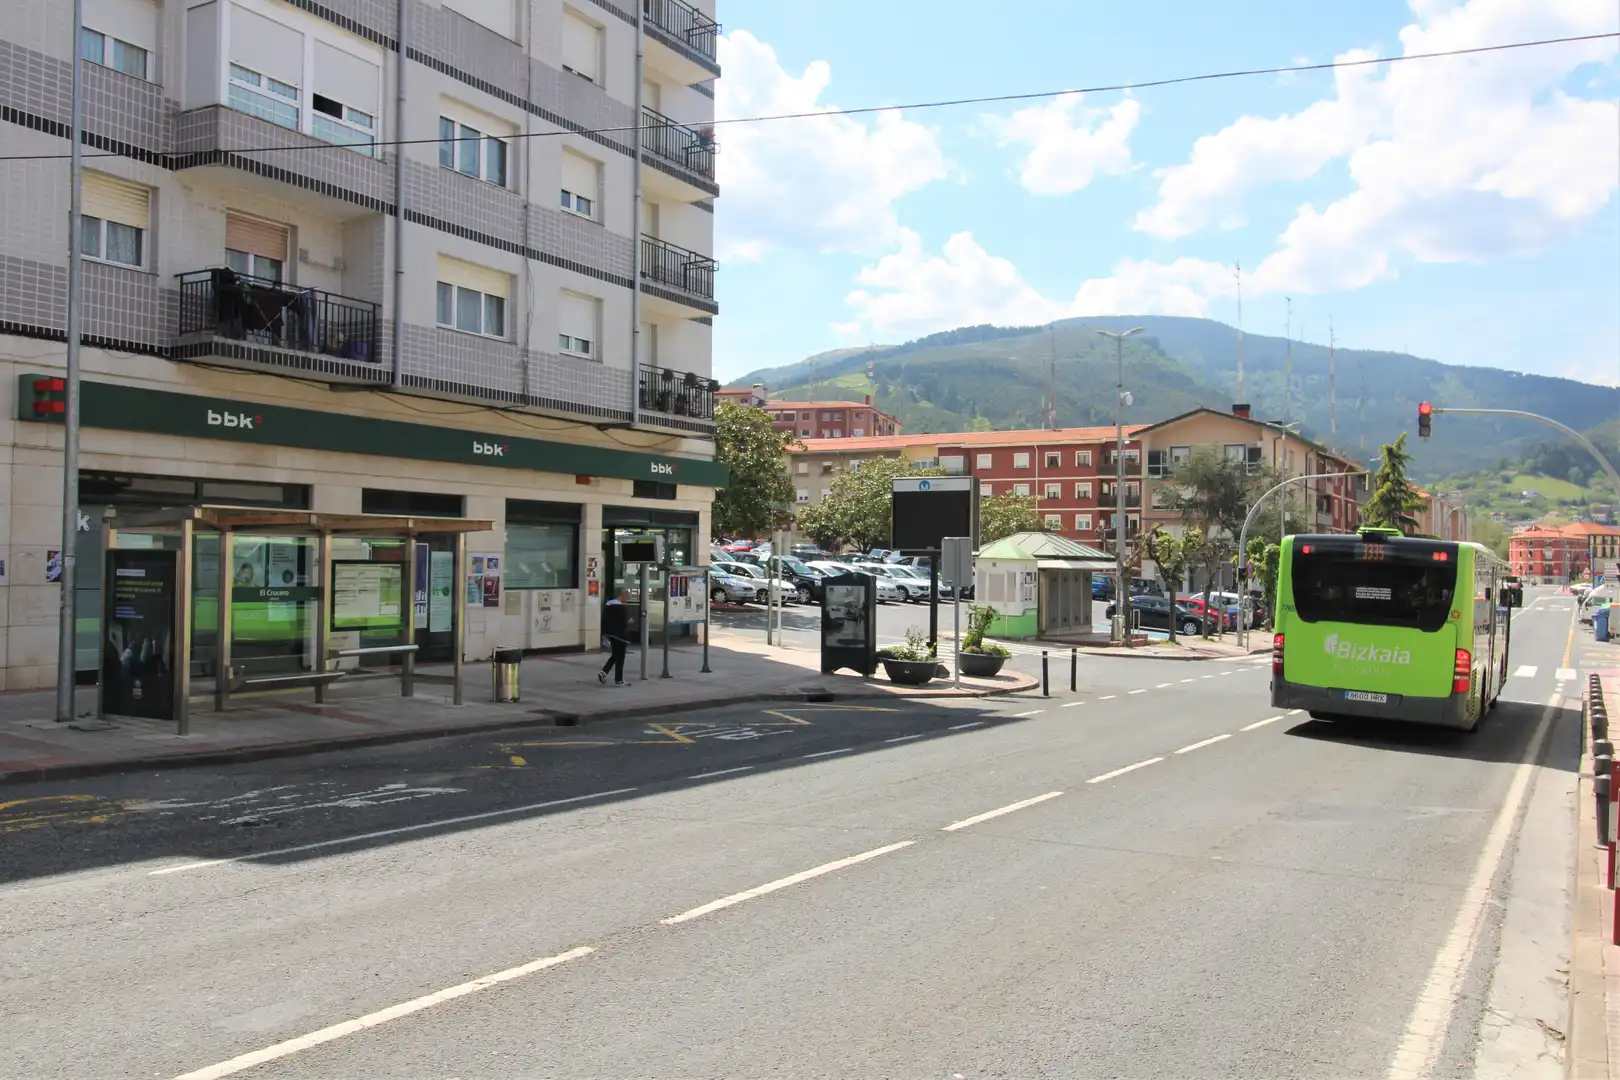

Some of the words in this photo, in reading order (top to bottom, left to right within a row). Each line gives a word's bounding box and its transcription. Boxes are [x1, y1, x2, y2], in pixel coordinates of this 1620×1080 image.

[207, 409, 254, 429] bbk
[473, 441, 504, 457] bbk
[651, 462, 673, 475] bbk
[1336, 641, 1411, 664] Bizkaia
